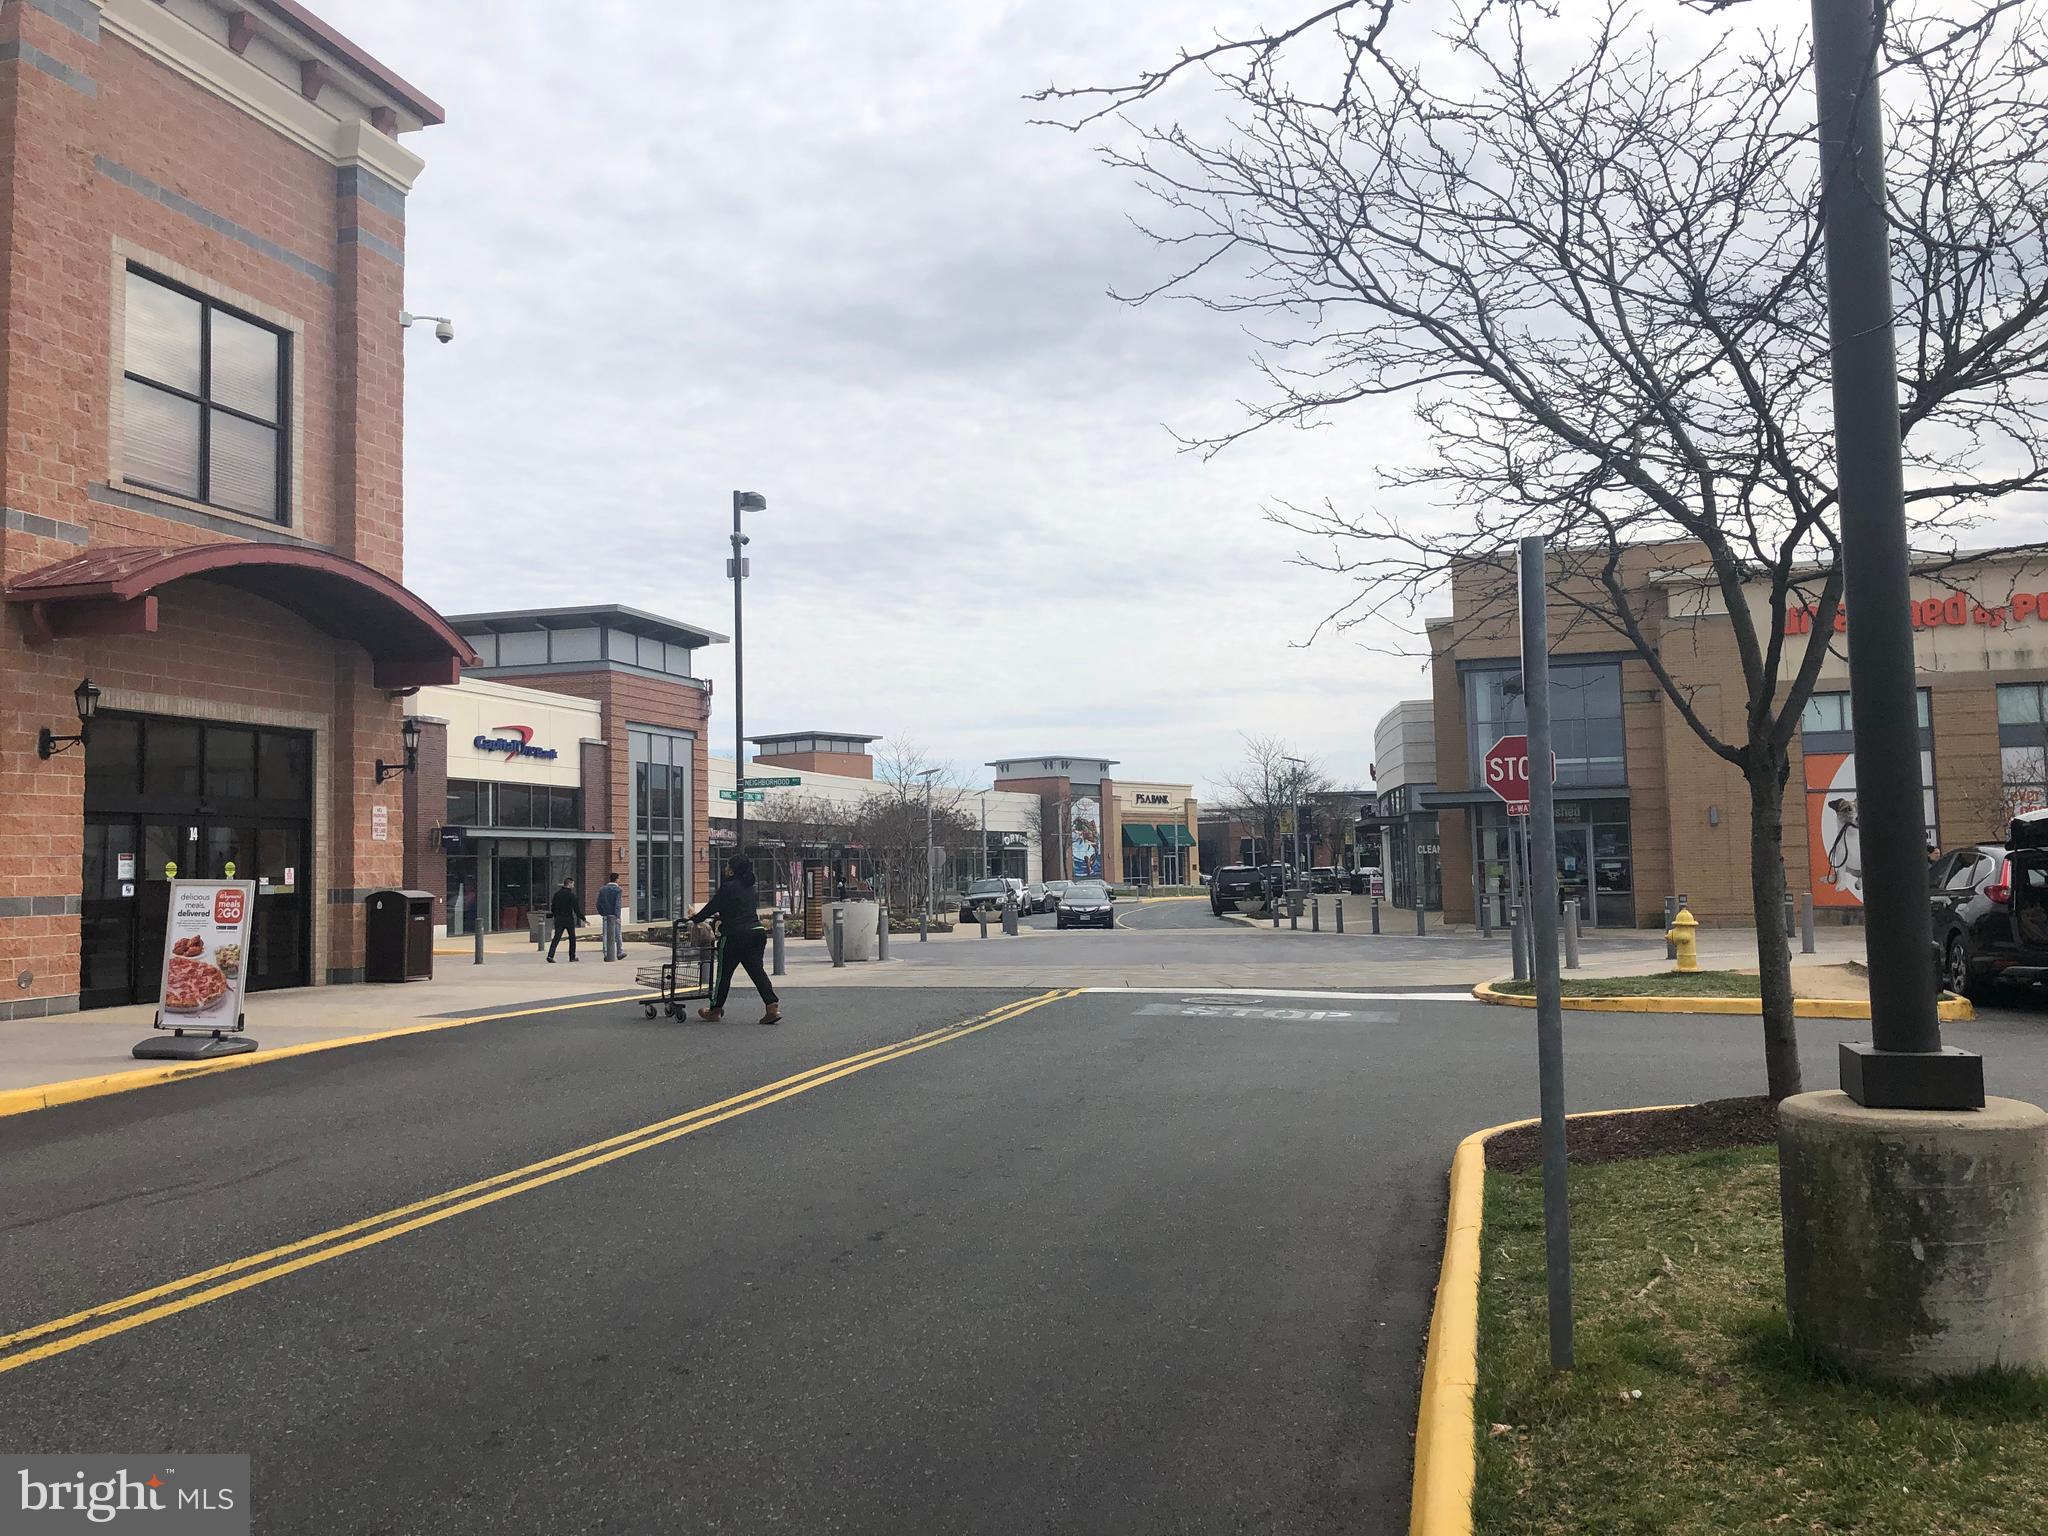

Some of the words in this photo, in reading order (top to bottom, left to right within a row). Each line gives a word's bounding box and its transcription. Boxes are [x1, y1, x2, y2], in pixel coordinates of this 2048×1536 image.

[474, 735, 518, 753] Capital
[1490, 757, 1530, 782] STO
[744, 778, 790, 787] NEIGHBORHOOD
[1509, 804, 1530, 813] 4-WA
[189, 827, 198, 841] 14
[181, 893, 210, 901] delicious
[218, 900, 241, 908] meals
[177, 909, 211, 917] delivered
[217, 908, 241, 918] 2GO
[1181, 1006, 1353, 1020] STOP
